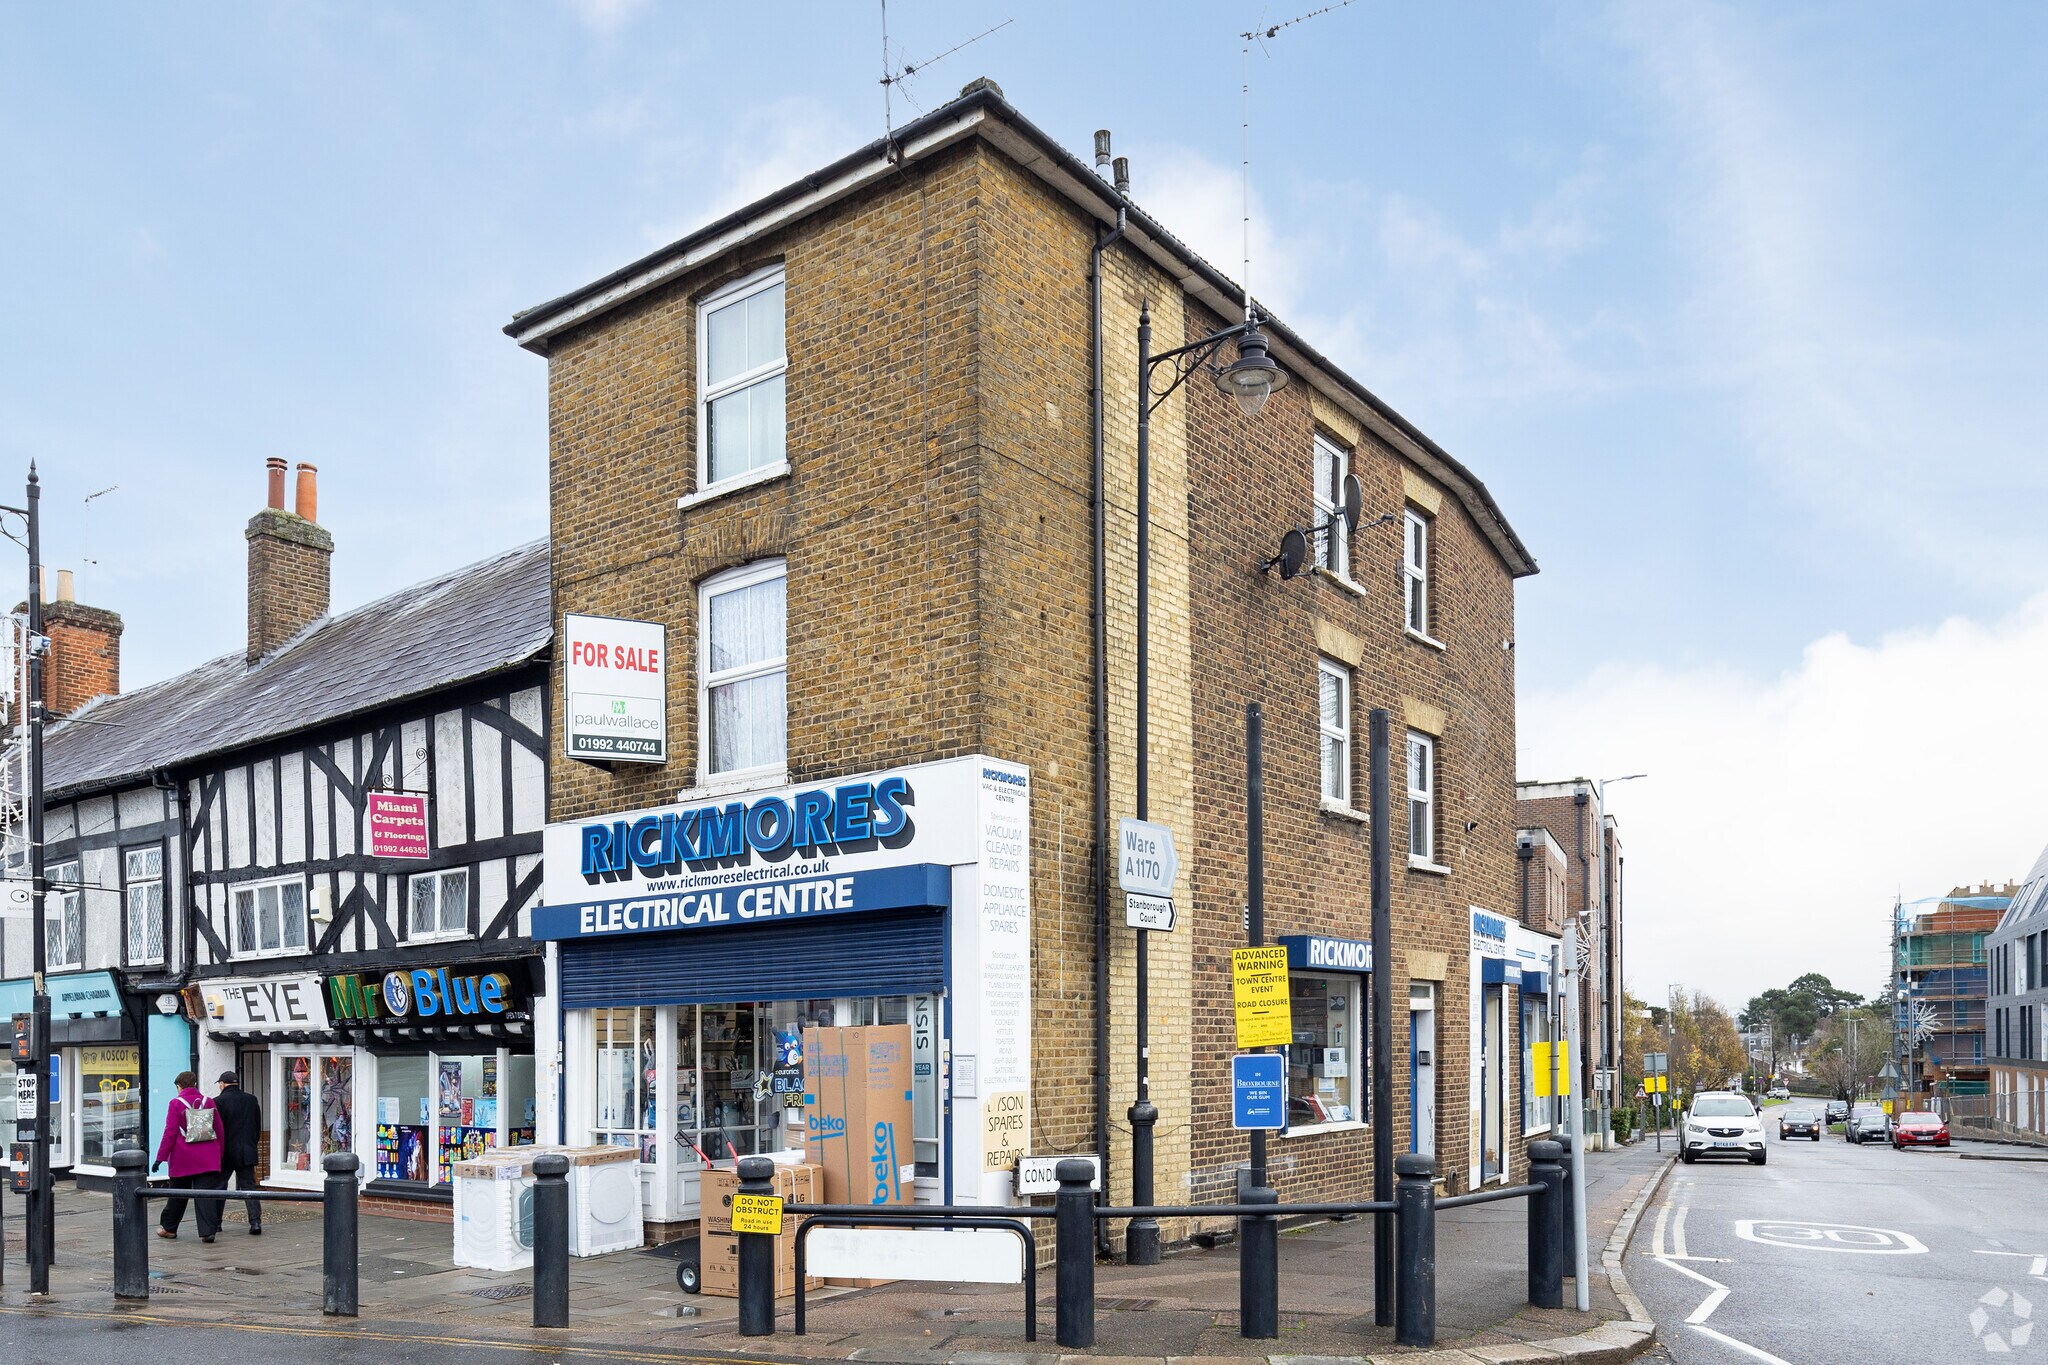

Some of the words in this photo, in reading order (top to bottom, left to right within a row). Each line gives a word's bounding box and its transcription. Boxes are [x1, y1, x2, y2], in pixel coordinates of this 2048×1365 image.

[573, 641, 608, 668] FOR
[615, 645, 659, 673] SALE
[575, 713, 660, 730] paulwallace
[579, 738, 613, 751] 01992
[616, 740, 656, 753] 440744
[983, 768, 1027, 787] RICKMORES
[982, 783, 992, 791] VAC
[998, 786, 1026, 798] ELECTRICAL
[995, 794, 1014, 804] CENTRE
[377, 801, 418, 813] Miami
[372, 813, 424, 827] Carpets
[581, 777, 912, 880] RICKMORES
[985, 824, 1021, 840] VACUUM
[374, 831, 382, 839] &
[384, 832, 425, 842] Floorings
[1126, 831, 1155, 854] Ware
[374, 845, 399, 853] 01992
[400, 846, 428, 854] 446355
[986, 841, 1022, 856] CLEANER
[989, 857, 1019, 873] REPAIRS
[646, 859, 830, 893] www.rickmoreselectrical.co.uk
[984, 884, 1024, 900] DOMESTIC
[580, 890, 730, 933] ELECTRICAL
[737, 877, 855, 919] CENTRE
[983, 902, 1026, 918] APPLIANCE
[1128, 898, 1167, 913] Stanborough
[1140, 912, 1156, 924] Court
[990, 919, 1018, 933] SPARES
[1235, 949, 1286, 961] ADVANCED
[1237, 960, 1284, 971] WARNING
[1236, 977, 1259, 985] TOWN
[1261, 975, 1287, 984] CENTRE
[329, 974, 380, 1020] Mr
[410, 966, 508, 1017] Blue
[1251, 985, 1273, 993] EVENT
[223, 987, 242, 1000] THE
[241, 982, 308, 1023] EYE
[1259, 998, 1288, 1007] CLOSURE
[100, 1049, 129, 1062] MOSCOT
[18, 1079, 35, 1088] STOP
[1237, 1079, 1280, 1088] BROXBOURNE
[18, 1090, 35, 1100] HERE
[987, 1096, 1023, 1112] YSON
[809, 1114, 846, 1131] beko
[988, 1114, 1023, 1132] SPARES
[1001, 1132, 1009, 1147] &
[871, 1121, 889, 1205] beko
[741, 1198, 753, 1206] DO
[757, 1199, 774, 1207] NOT
[796, 1193, 805, 1203] LG
[735, 1206, 779, 1216] OBSTRUCT
[1759, 1225, 1893, 1245] 30
